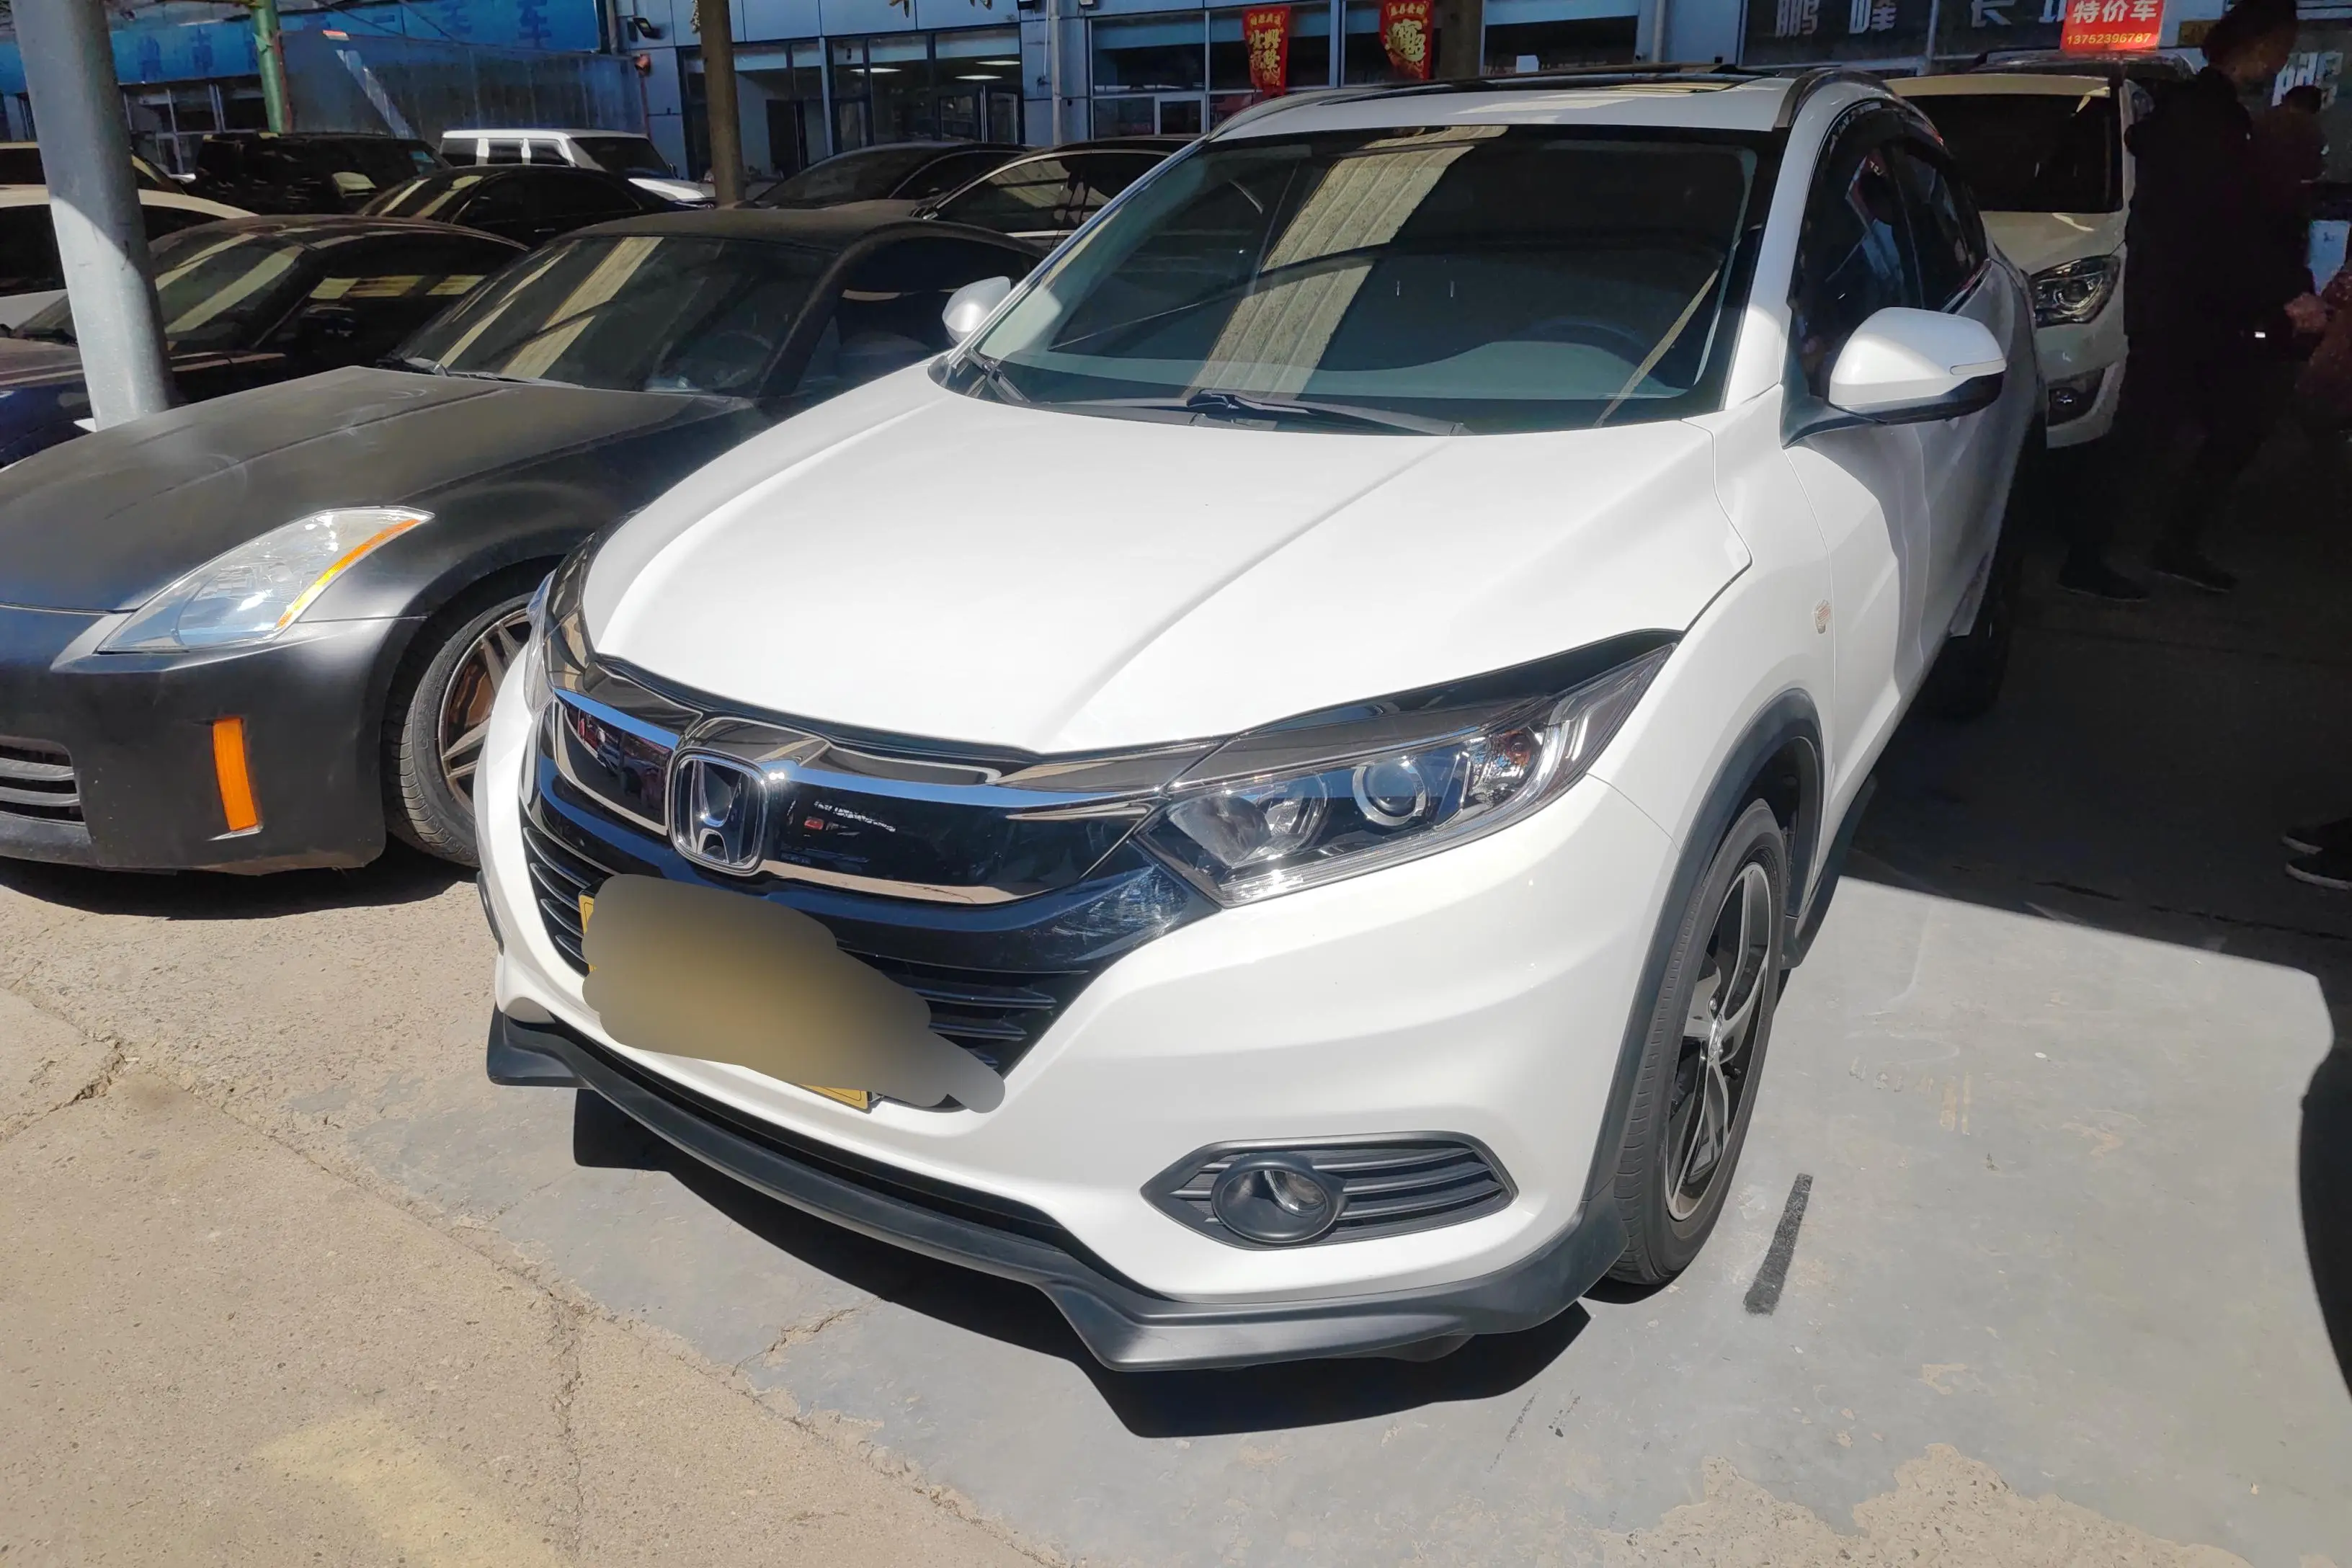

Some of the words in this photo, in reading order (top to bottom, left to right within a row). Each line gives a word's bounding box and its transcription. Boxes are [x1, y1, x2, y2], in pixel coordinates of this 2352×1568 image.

[2072, 0, 2160, 24] 特价车
[2067, 32, 2152, 45] 13752396787
